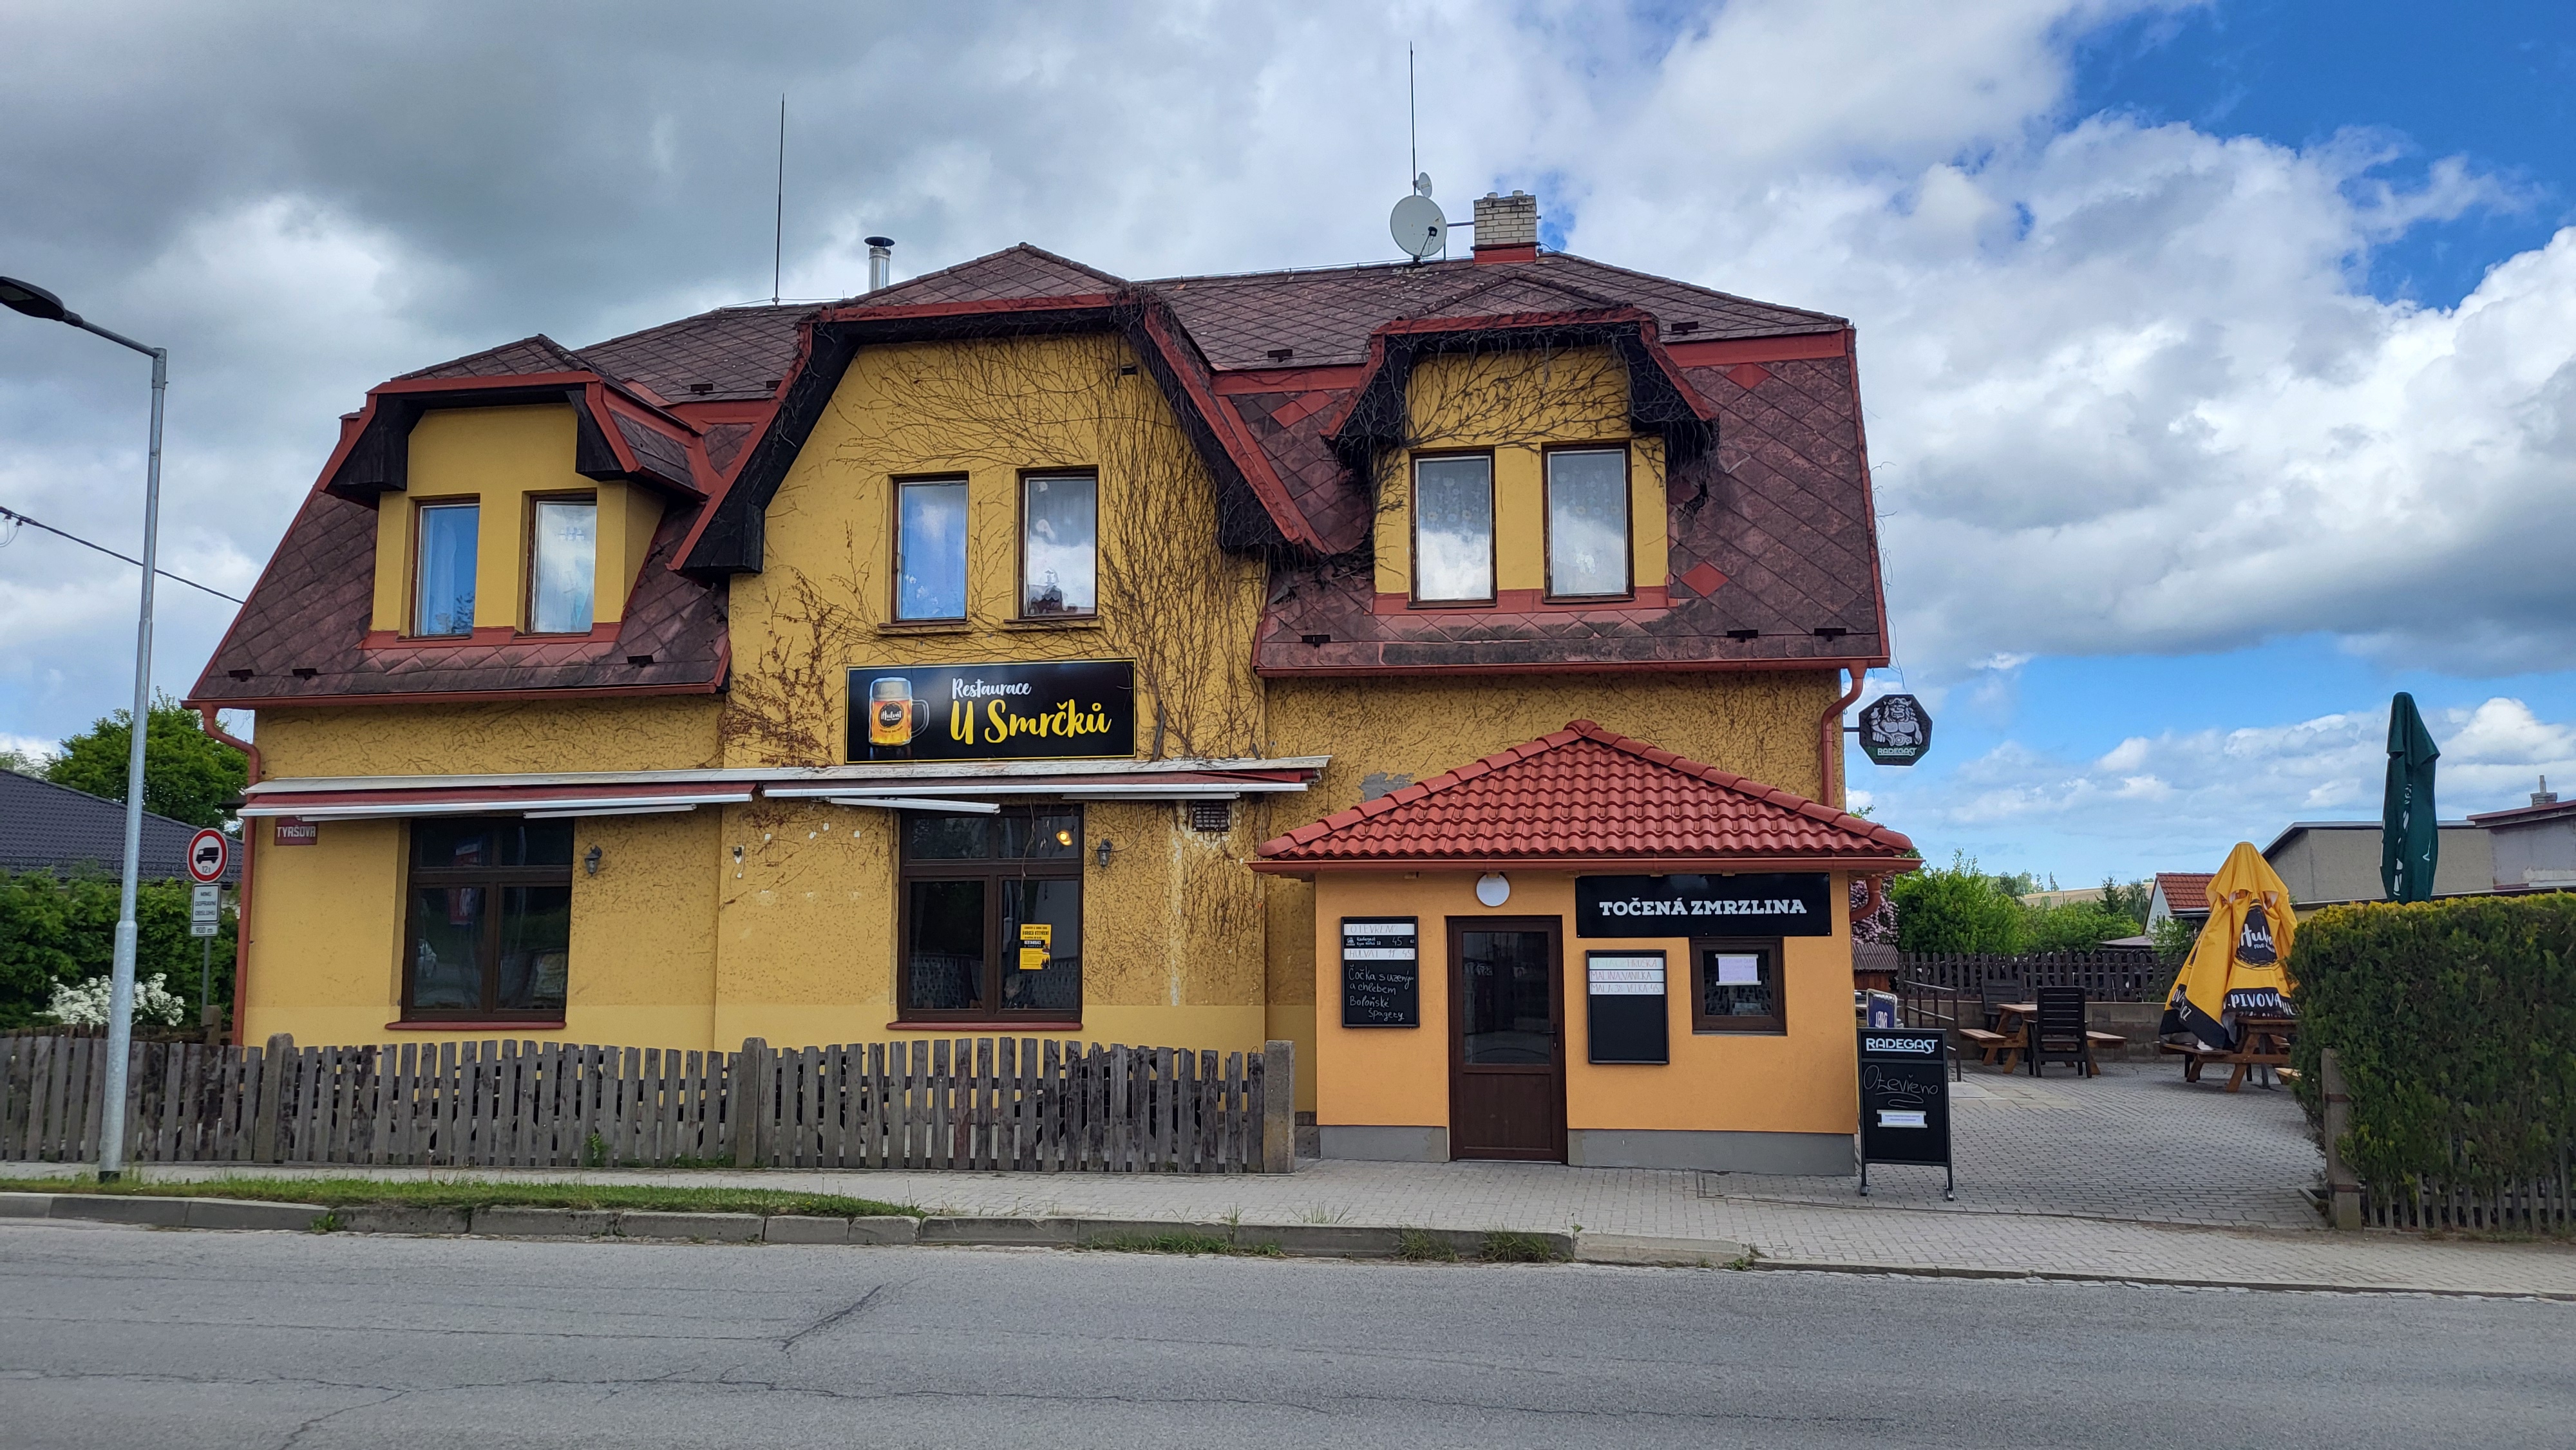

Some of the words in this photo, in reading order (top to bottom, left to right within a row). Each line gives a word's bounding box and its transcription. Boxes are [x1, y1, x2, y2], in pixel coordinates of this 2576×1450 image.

[952, 678, 1032, 700] Restaurace
[950, 700, 974, 744] U
[984, 699, 1112, 743] Smrčků
[1877, 748, 1917, 756] RADEGAST
[1600, 898, 1688, 916] TOČENÁ
[1691, 899, 1807, 915] ZMRZLINA
[1392, 936, 1403, 946] 45
[1349, 964, 1376, 981] Čočka
[1358, 982, 1396, 995] chlebem
[1866, 1038, 1938, 1054] RADEGAST
[1864, 1064, 1938, 1095] Otevřeno
